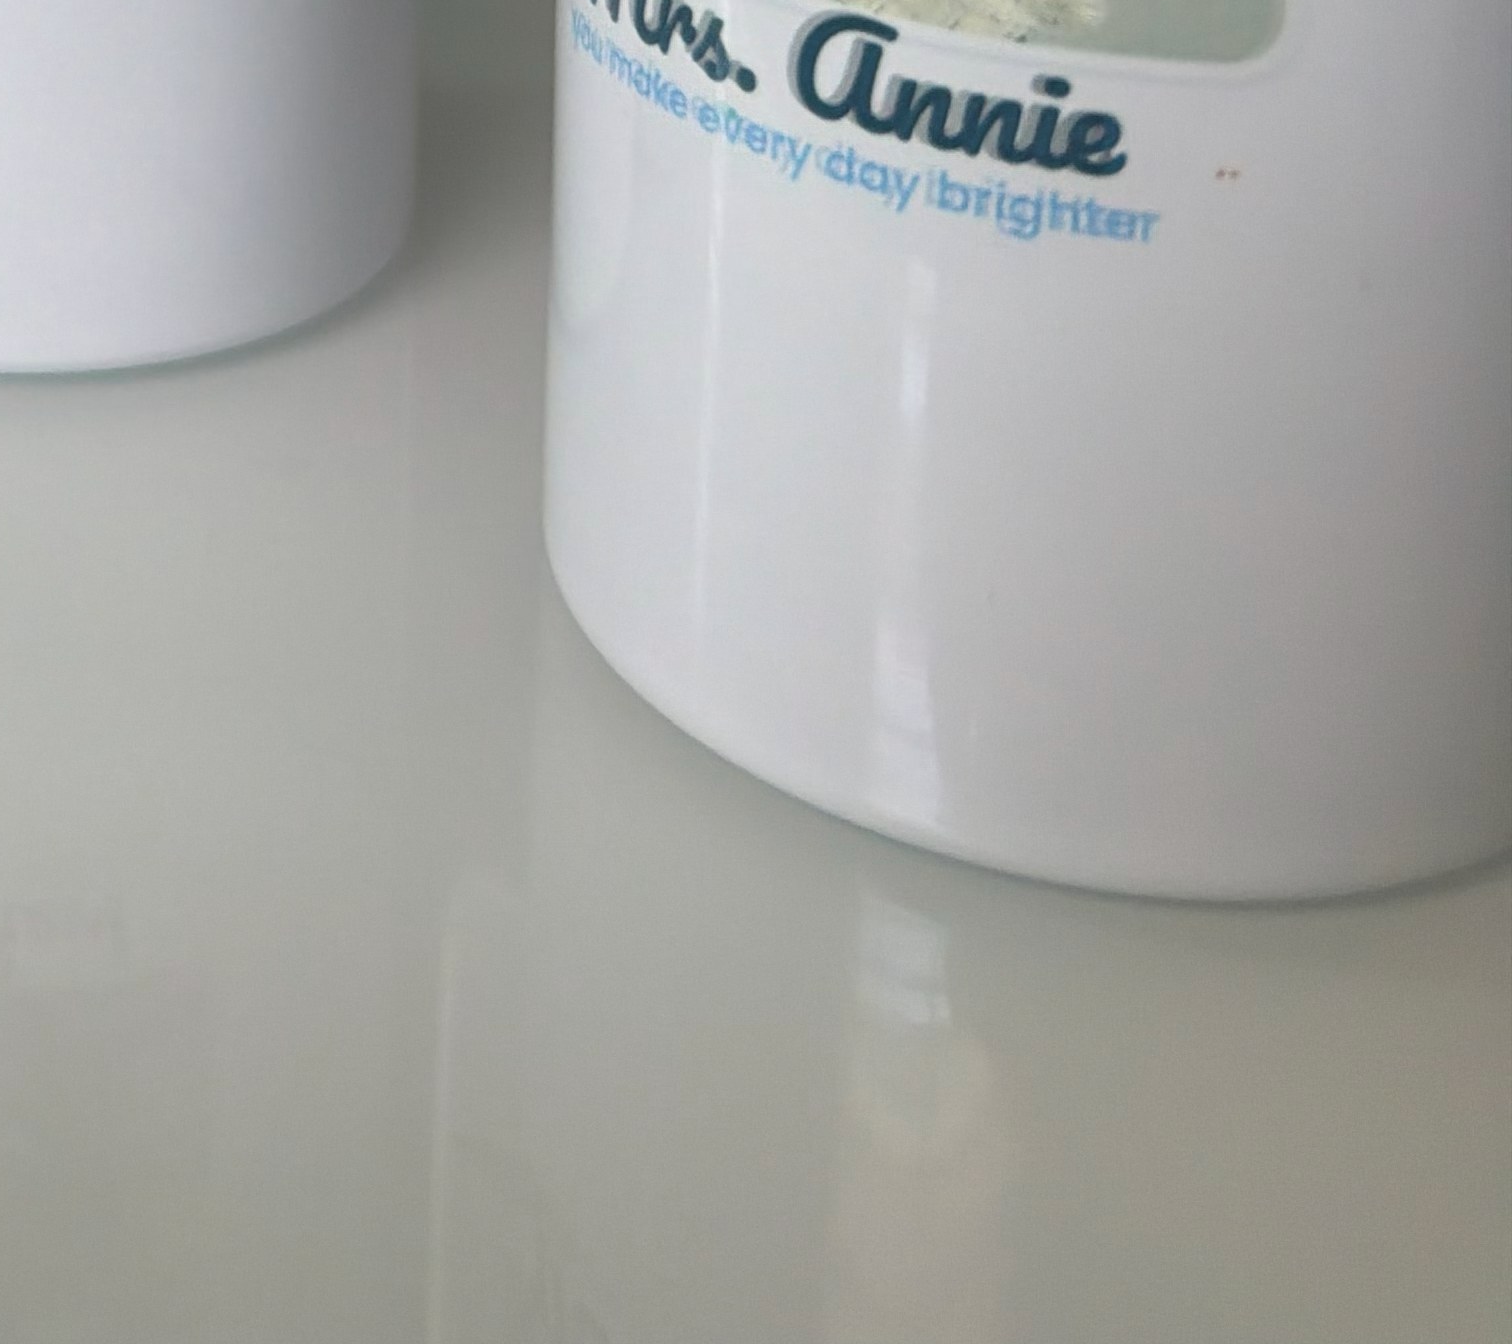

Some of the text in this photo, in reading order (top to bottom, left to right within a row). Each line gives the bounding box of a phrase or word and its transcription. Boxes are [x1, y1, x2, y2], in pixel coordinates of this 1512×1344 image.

[606, 36, 688, 119] make
[691, 95, 813, 182] every
[815, 144, 920, 212] day
[926, 166, 1160, 243] brighter
[788, 10, 1128, 178] Annie
